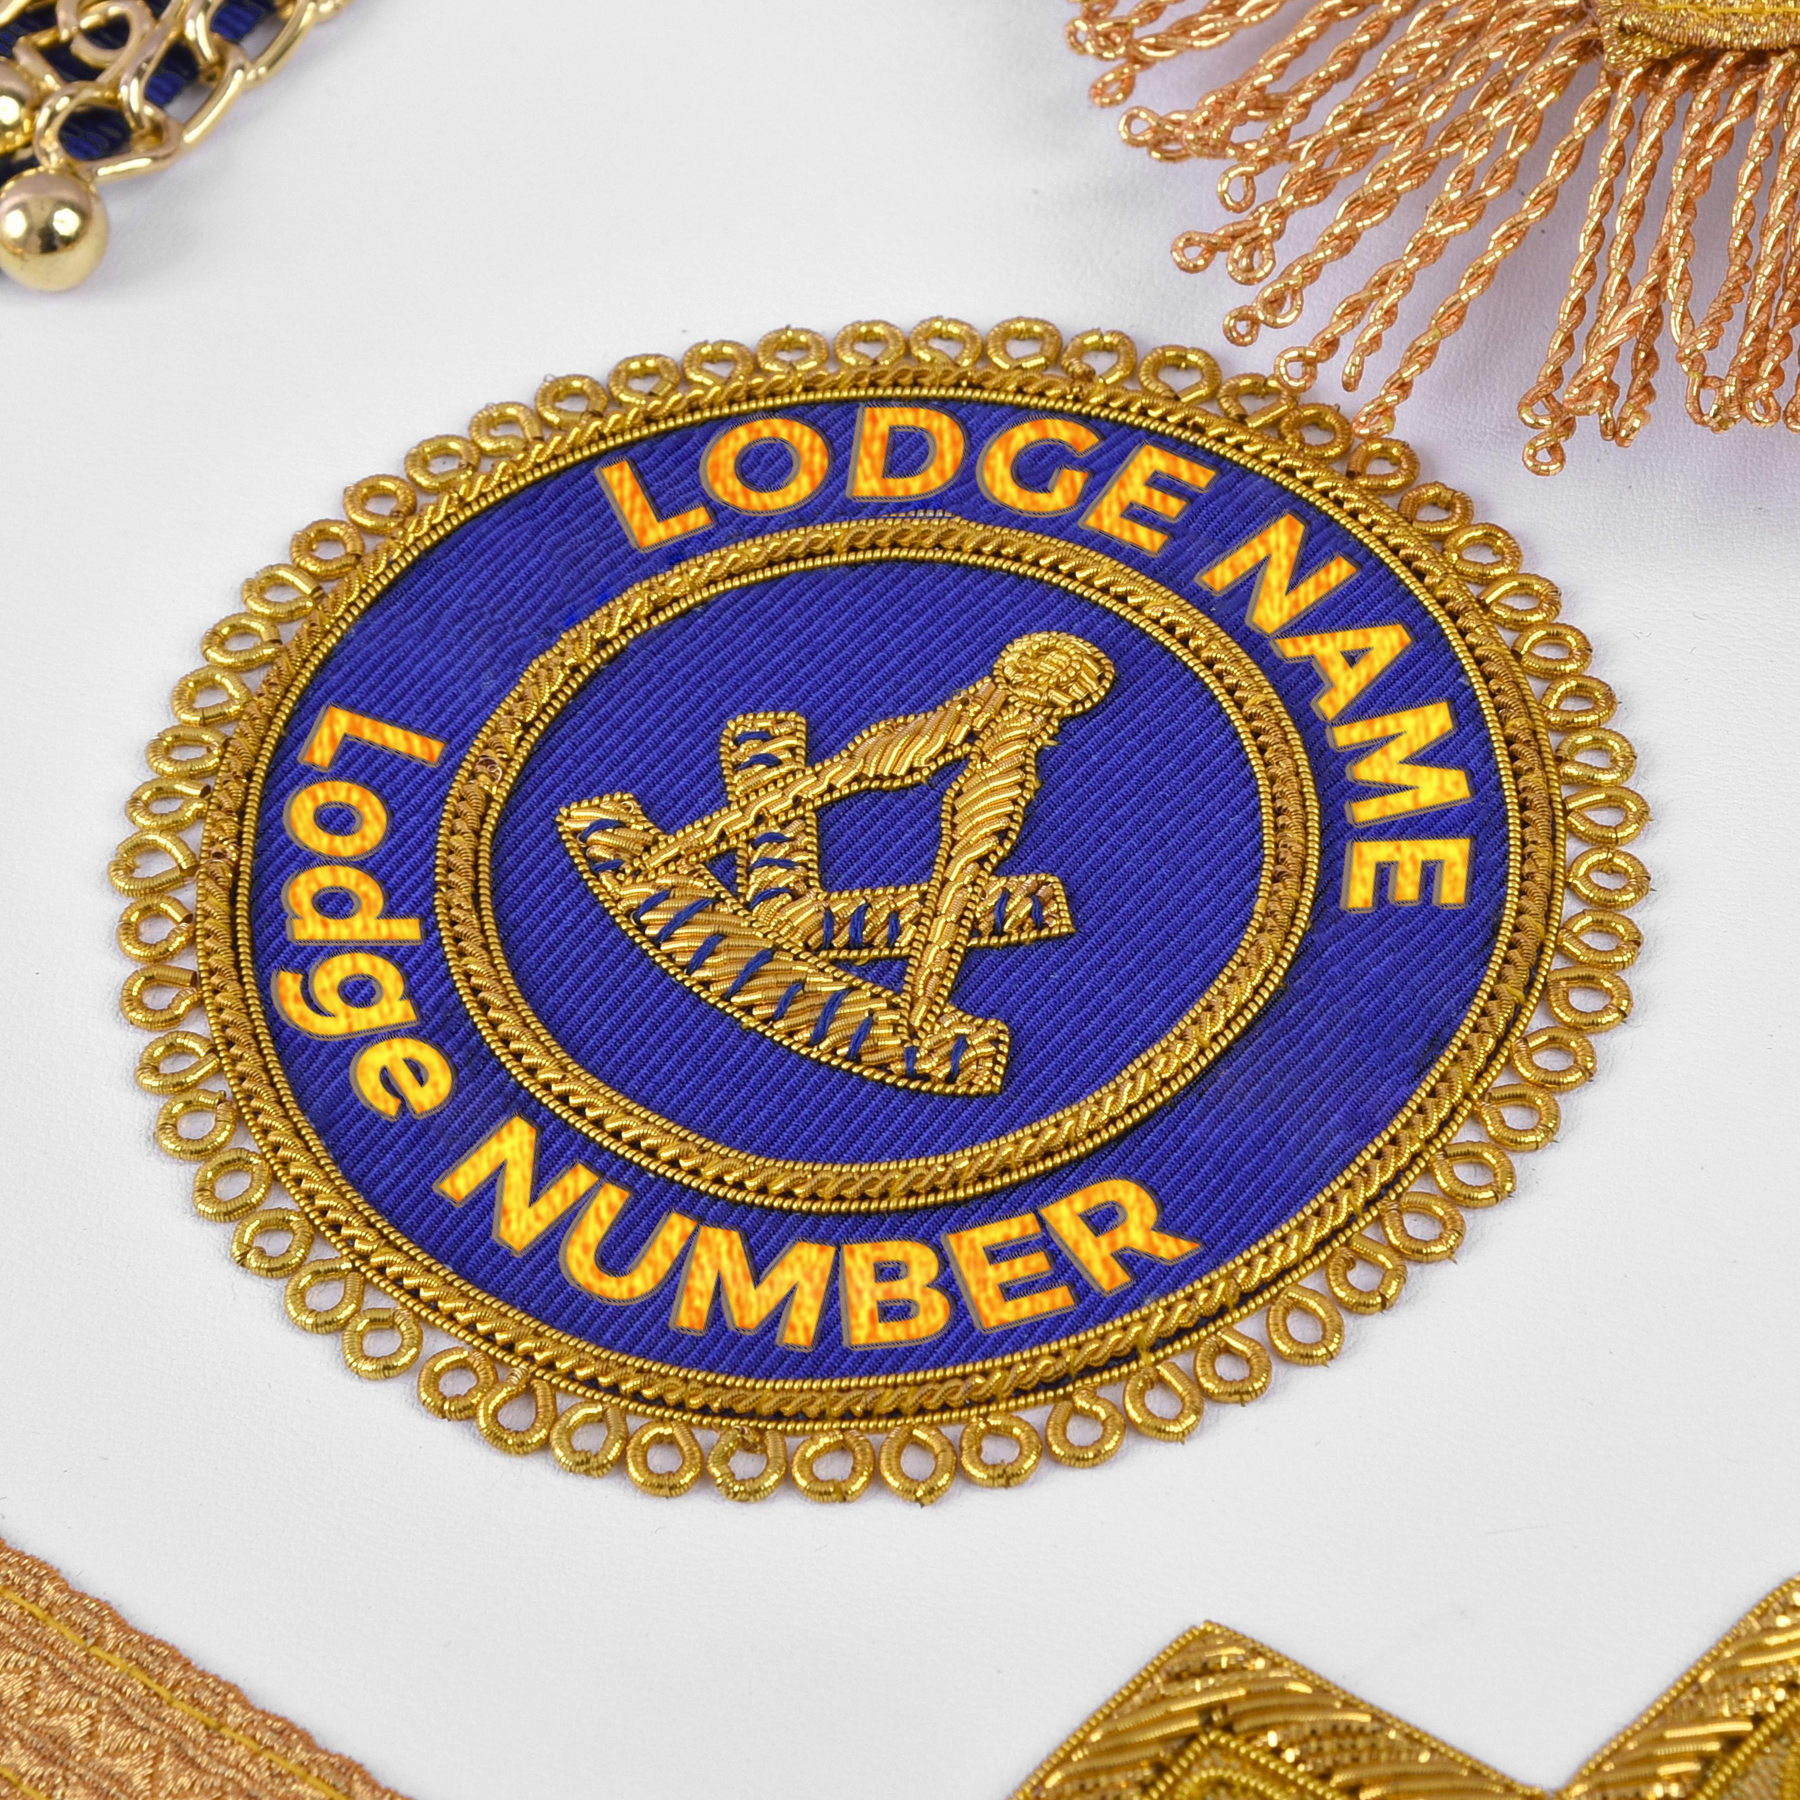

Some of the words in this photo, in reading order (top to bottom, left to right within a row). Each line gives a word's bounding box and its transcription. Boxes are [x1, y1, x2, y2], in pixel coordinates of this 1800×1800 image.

[596, 404, 1216, 553] LODGE
[1197, 511, 1472, 912] NAME
[270, 703, 457, 1118] Lodge
[433, 1112, 1200, 1349] NUMBER
